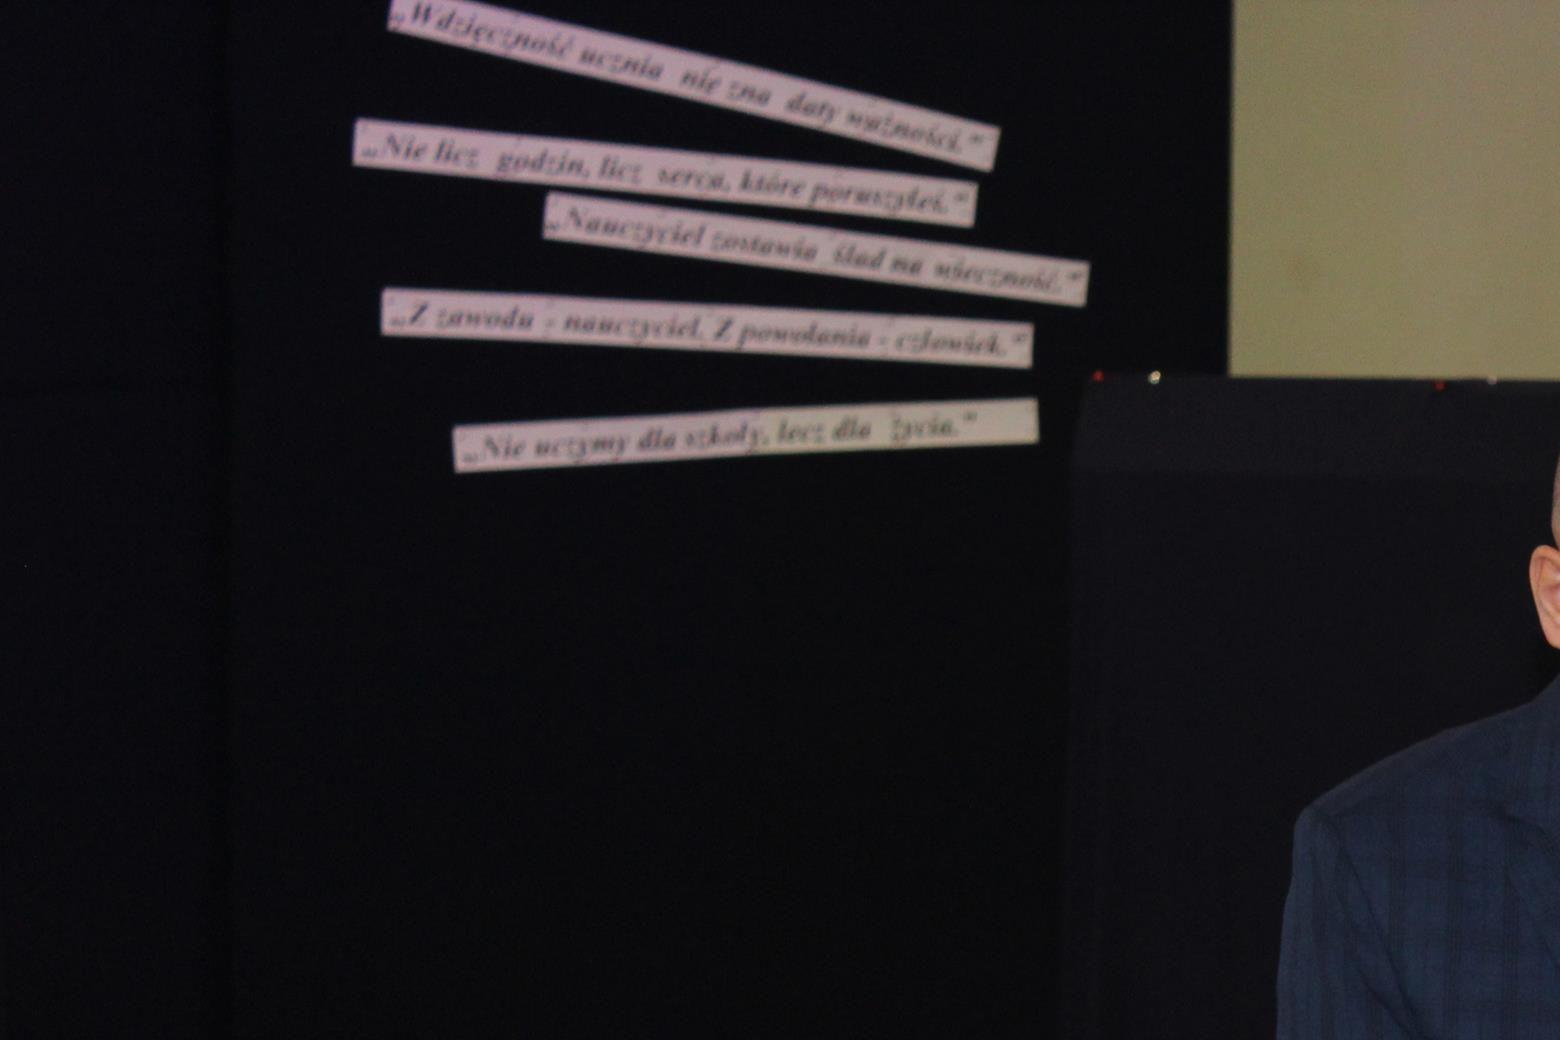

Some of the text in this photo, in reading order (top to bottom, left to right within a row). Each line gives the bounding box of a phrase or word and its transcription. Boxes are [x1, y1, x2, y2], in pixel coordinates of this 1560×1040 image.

[579, 46, 663, 81] ucznia
[680, 64, 722, 95] nie
[785, 87, 836, 122] daty
[434, 139, 479, 168] licz
[599, 152, 643, 184] licz
[739, 169, 805, 197] które
[890, 252, 923, 275] na
[436, 303, 534, 332] zawodu
[535, 435, 627, 463] uczymy
[638, 427, 676, 451] dla
[777, 417, 825, 444] lecz
[832, 415, 872, 441] dla
